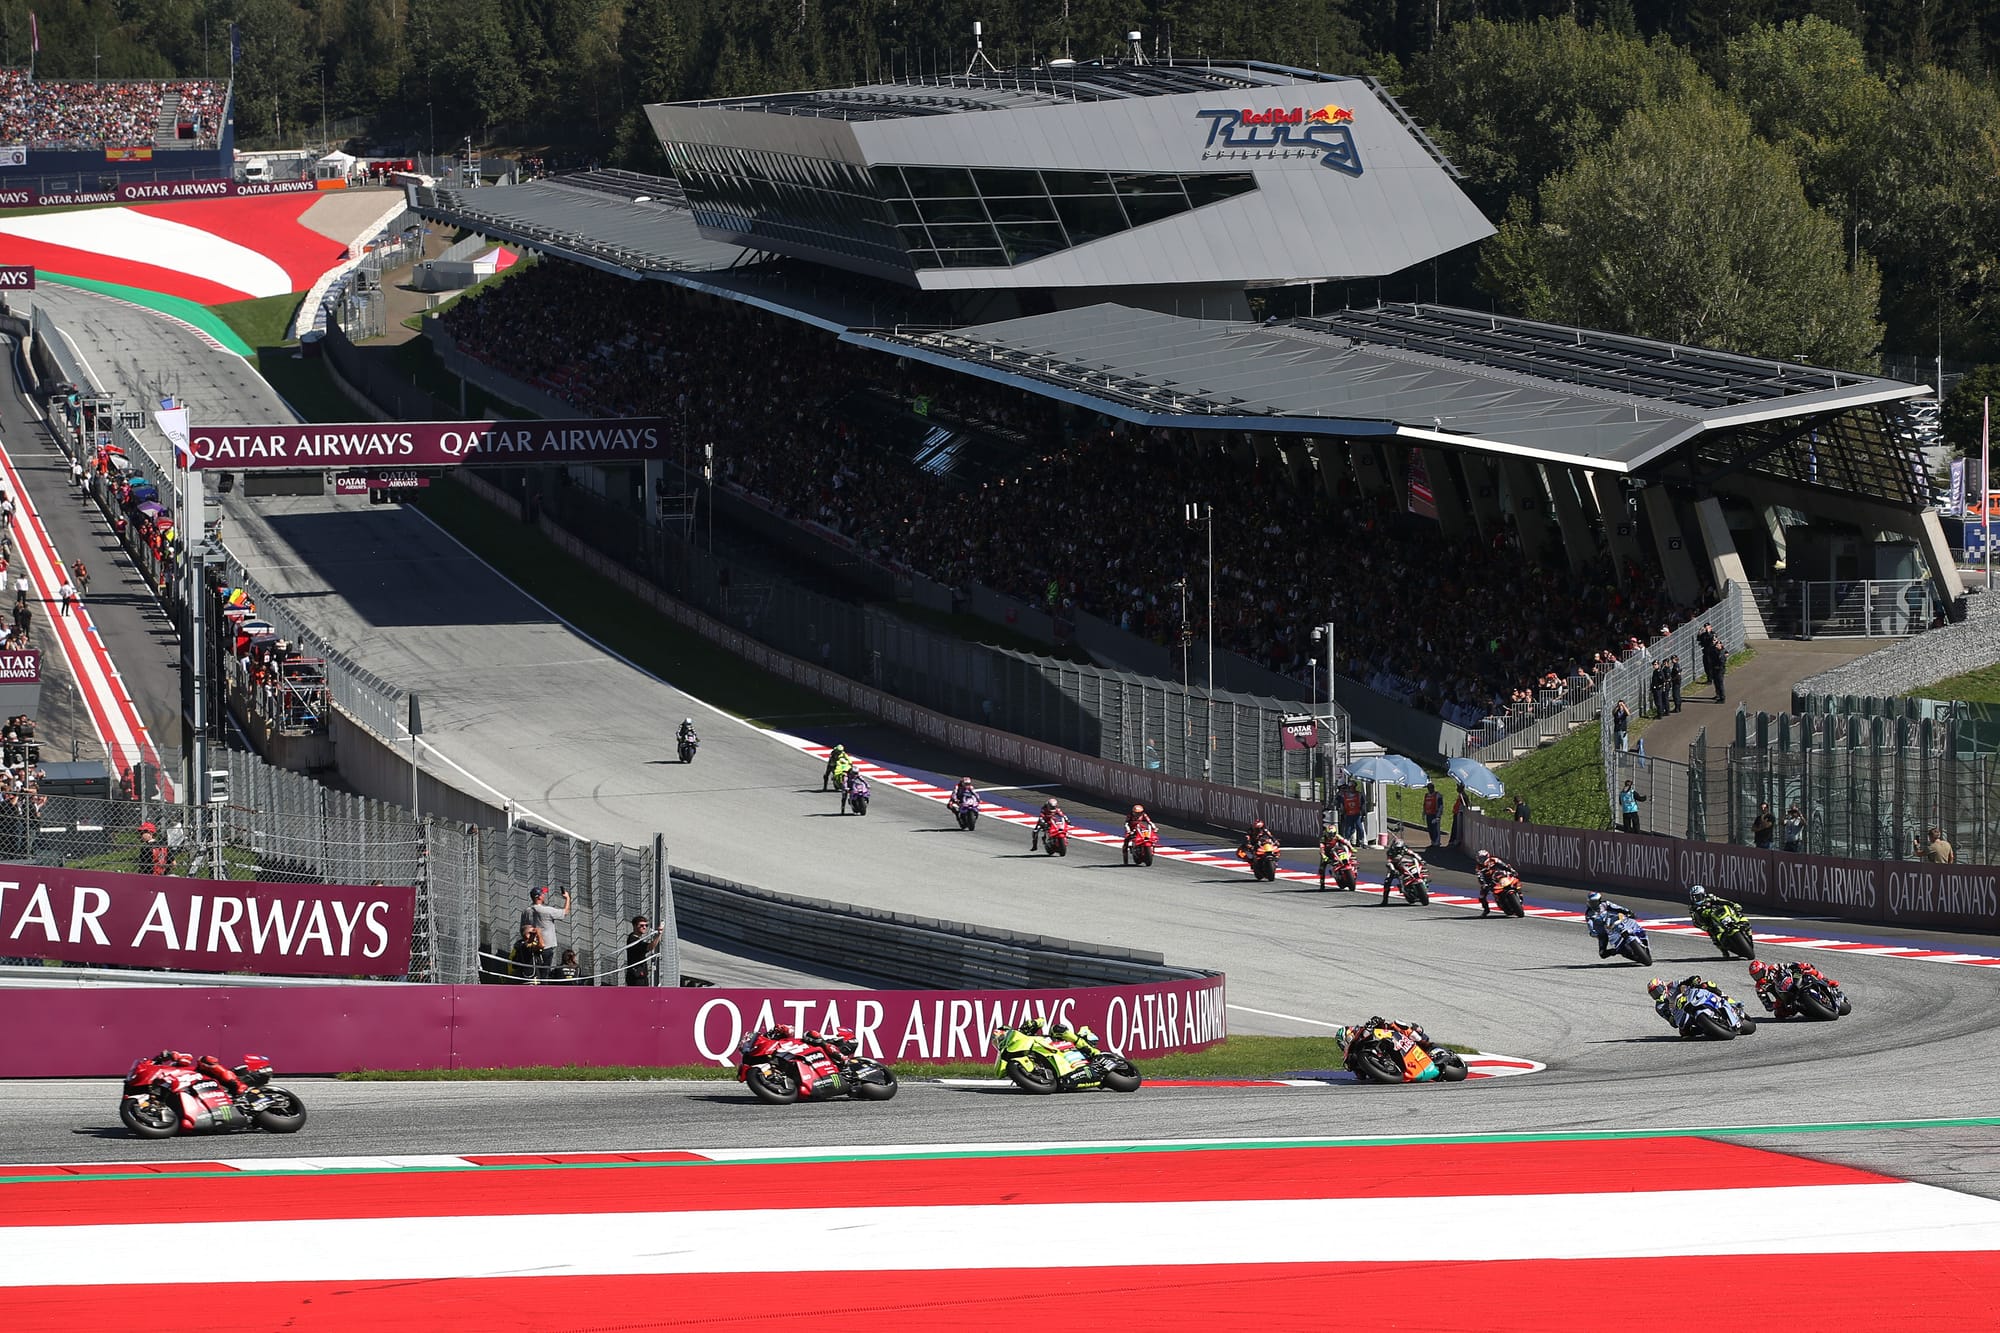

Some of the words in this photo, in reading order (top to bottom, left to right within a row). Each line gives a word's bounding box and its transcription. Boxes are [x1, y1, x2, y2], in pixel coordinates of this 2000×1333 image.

[1241, 108, 1272, 124] Red
[1274, 107, 1302, 124] Bull
[39, 195, 72, 205] QATAR
[74, 193, 116, 204] AIRWAYS
[125, 185, 169, 199] QATAR
[172, 182, 227, 195] AIRWAYS
[237, 184, 270, 196] QATAR
[273, 181, 314, 192] AIRWAYS
[193, 434, 286, 460] QATAR
[294, 432, 414, 456] AIRWAYS
[440, 430, 532, 456] QATAR
[541, 428, 658, 450] AIRWAYS
[337, 477, 366, 486] QATAR
[1287, 724, 1312, 734] QATAR
[1208, 790, 1230, 819] QATAR
[1264, 802, 1287, 831] QATAR
[1290, 807, 1320, 837] AIRWAYS
[1515, 831, 1540, 866] QATAR
[1541, 834, 1580, 870] AIRWAYS
[1588, 839, 1622, 877] QATAR
[1625, 843, 1670, 882] AIRWAYS
[1680, 850, 1716, 888] QATAR
[1719, 853, 1767, 895] AIRWAYS
[1778, 861, 1819, 902] QATAR
[1822, 866, 1876, 908] AIRWAYS
[1888, 871, 1934, 915] QATAR
[1937, 874, 1998, 917] AIRWAYS
[131, 891, 389, 959] AIRWAYS
[694, 998, 884, 1067] QATAR
[1106, 992, 1180, 1058] QATAR
